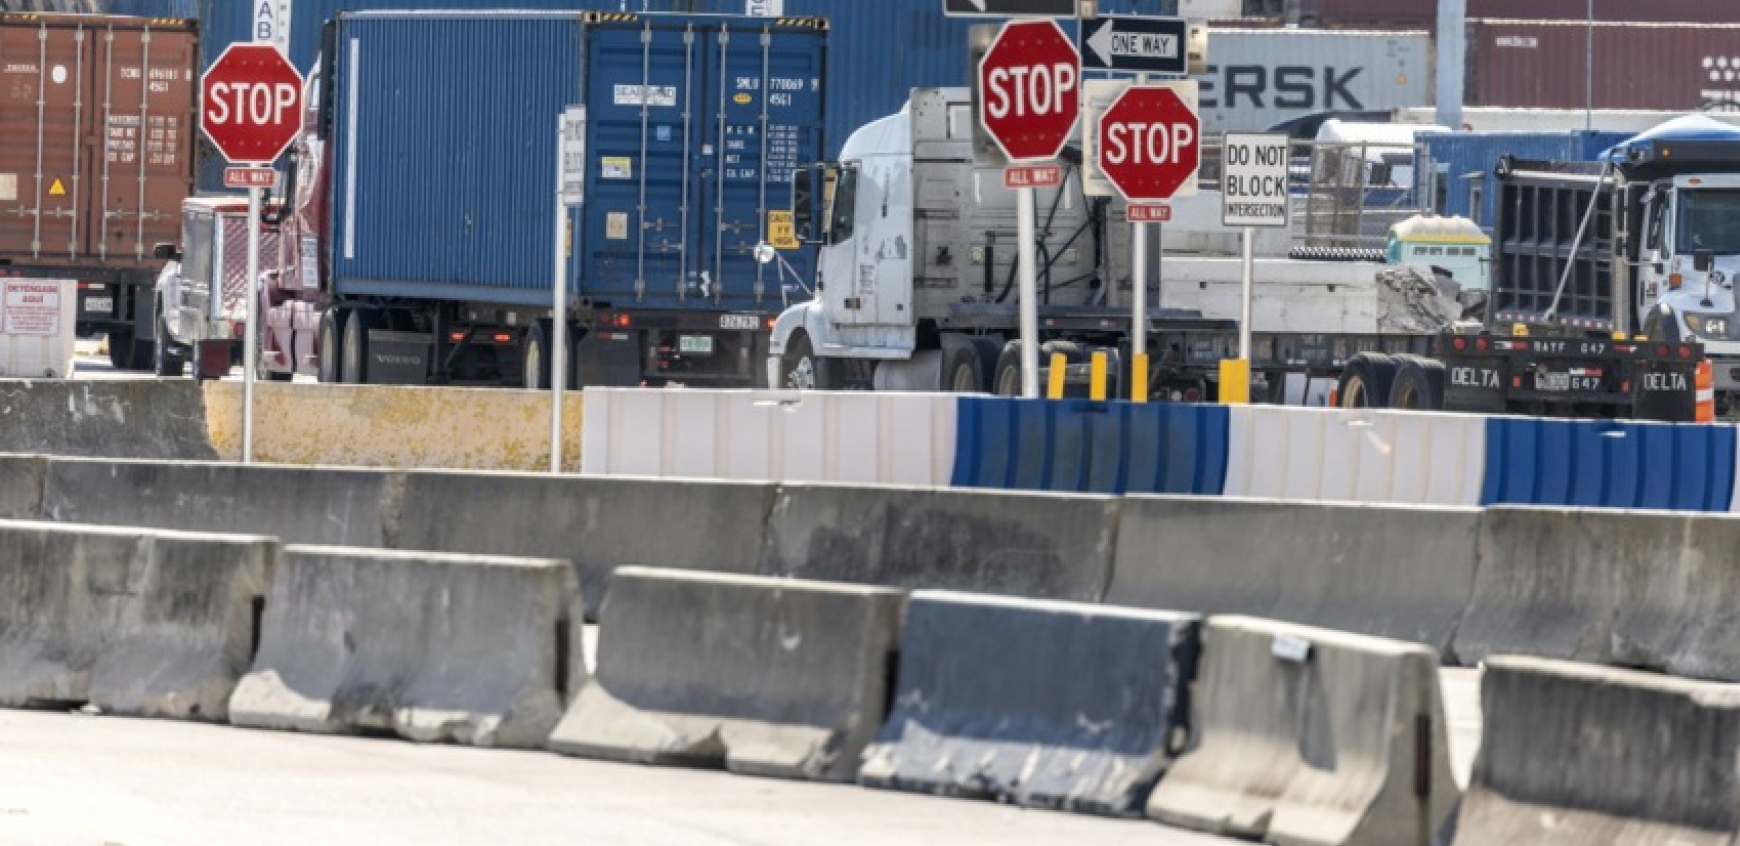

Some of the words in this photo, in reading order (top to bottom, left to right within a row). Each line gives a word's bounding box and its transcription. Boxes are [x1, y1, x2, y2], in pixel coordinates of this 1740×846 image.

[1112, 34, 1138, 52] ONE
[1143, 36, 1169, 53] WAY
[988, 63, 1075, 118] STOP
[208, 81, 297, 125] STOP
[1106, 122, 1193, 164] STOP
[1228, 144, 1249, 166] DO
[1255, 145, 1286, 166] NOT
[228, 172, 246, 182] ALL
[252, 172, 271, 182] WAY
[1009, 170, 1029, 184] ALL
[1034, 168, 1056, 182] WAY
[1227, 175, 1285, 197] BLOCK
[1130, 207, 1146, 218] ALL
[1150, 207, 1168, 218] WAY
[1227, 203, 1285, 217] INTERSECTION
[1452, 367, 1500, 388] DELTA
[1644, 374, 1687, 390] DELTA
